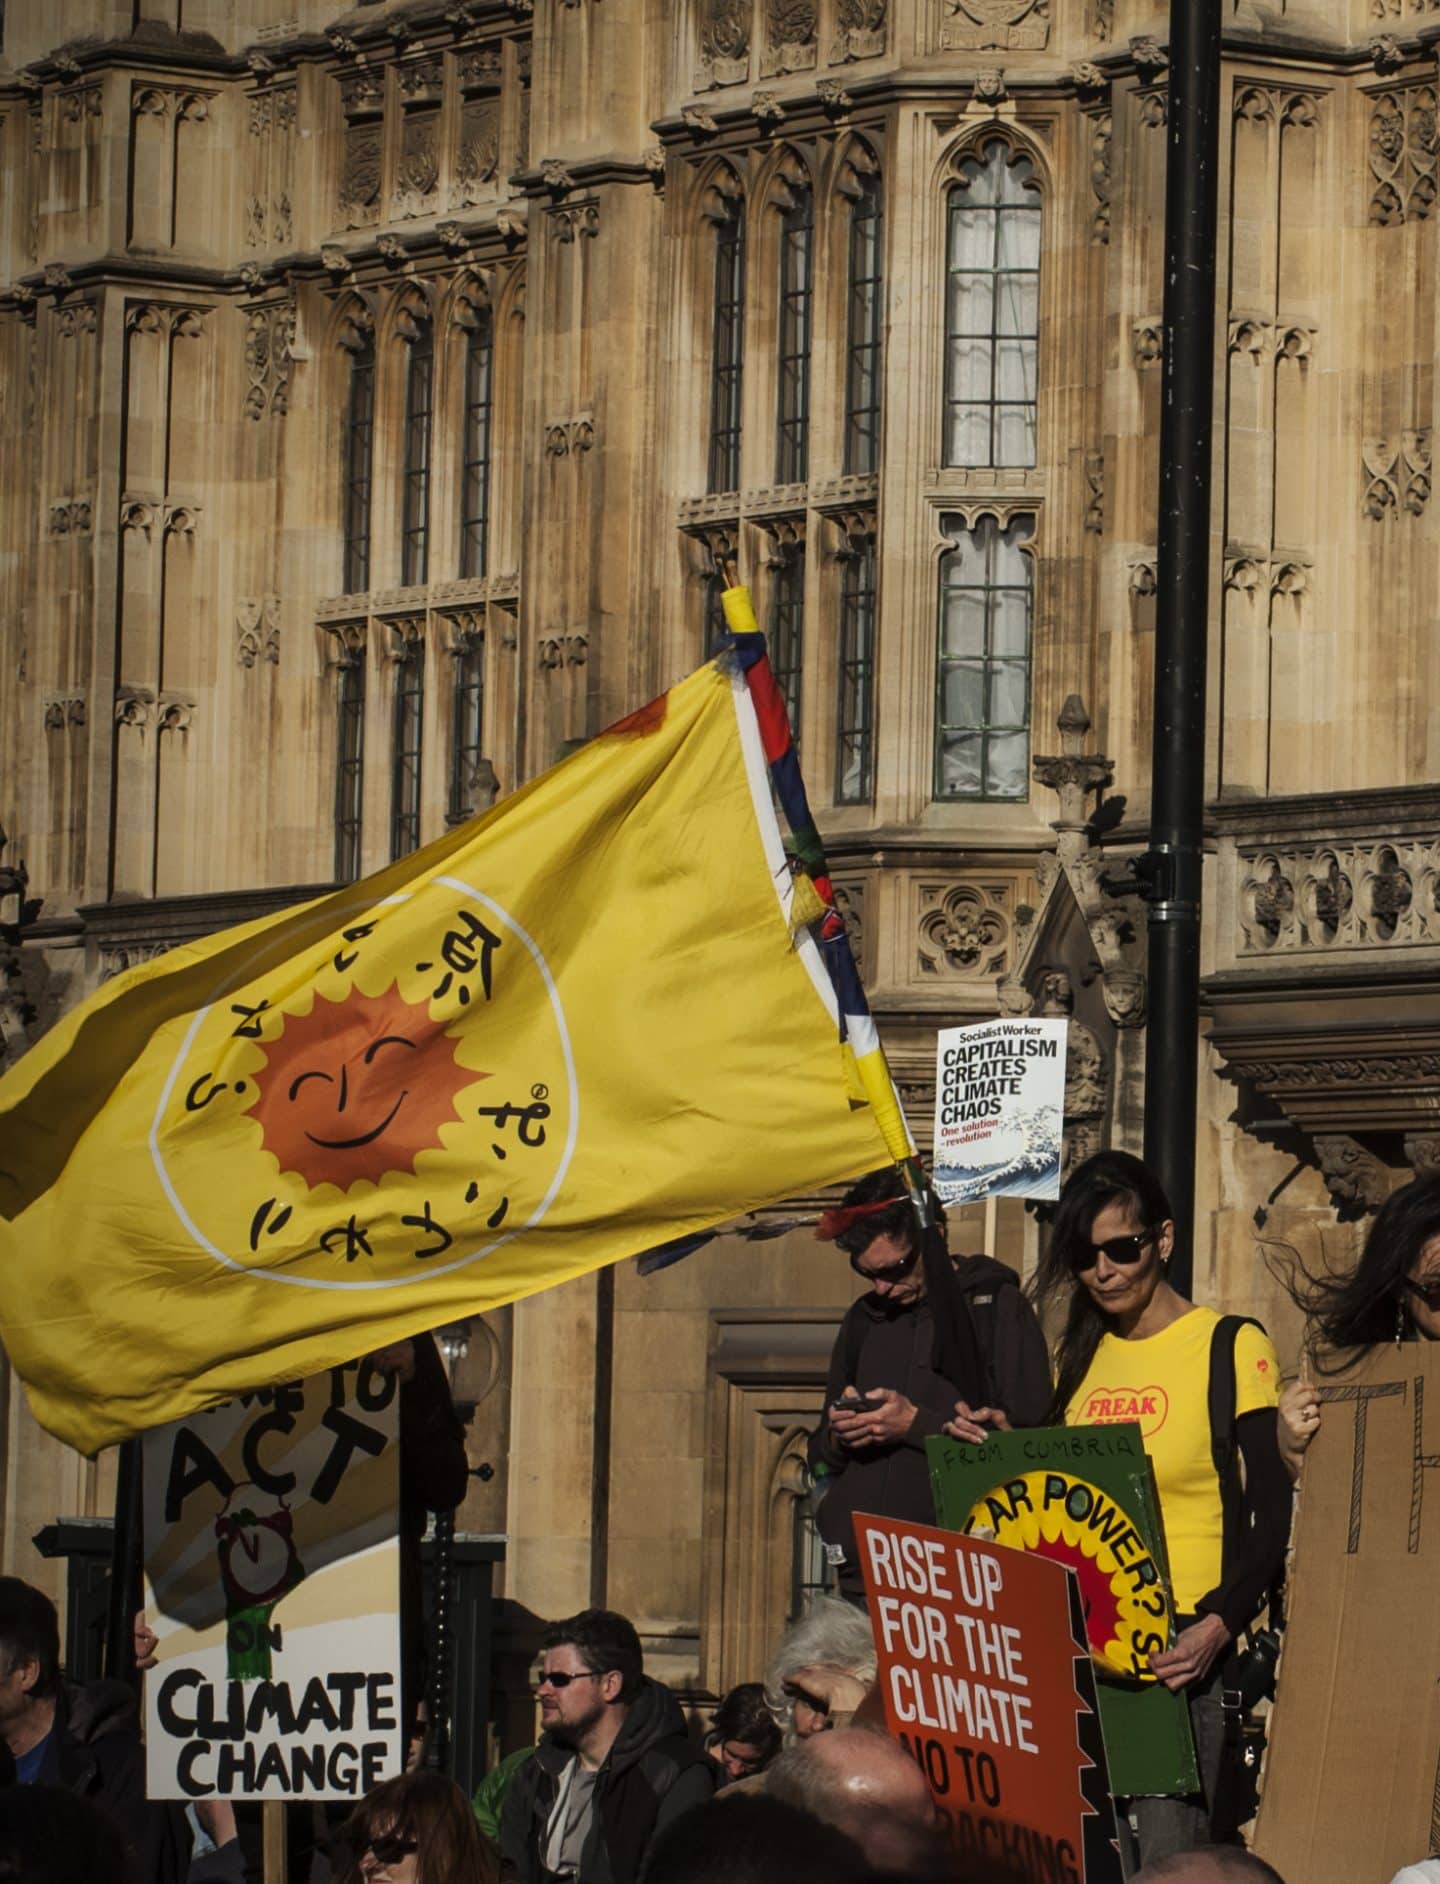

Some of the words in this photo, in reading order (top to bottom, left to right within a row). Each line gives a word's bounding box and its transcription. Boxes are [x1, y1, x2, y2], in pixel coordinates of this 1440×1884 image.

[959, 1026, 1001, 1044] Socialist
[1002, 1024, 1042, 1036] Worker
[942, 1058, 1027, 1086] CREATES
[943, 1039, 1058, 1068] CAPITALISM
[942, 1077, 1022, 1106] CLIMATE
[941, 1097, 1002, 1126] CHAOS
[941, 1126, 960, 1138] One
[961, 1119, 999, 1135] solution
[1085, 1396, 1158, 1418] FREAK
[164, 1405, 389, 1524] ACT
[943, 1441, 1004, 1472] FROM
[1023, 1434, 1136, 1461] CUMBRIA
[963, 1478, 1034, 1538] AR
[1043, 1474, 1166, 1619] POWER?
[865, 1528, 953, 1601] RISE
[955, 1548, 1004, 1612] UP
[228, 1620, 284, 1656] ON
[877, 1594, 954, 1667] FOR
[954, 1613, 1029, 1686] THE
[156, 1667, 397, 1742] CLIMATE
[890, 1664, 1040, 1755] CLIMATE
[175, 1738, 389, 1799] CHANGE
[954, 1745, 1001, 1808] TO
